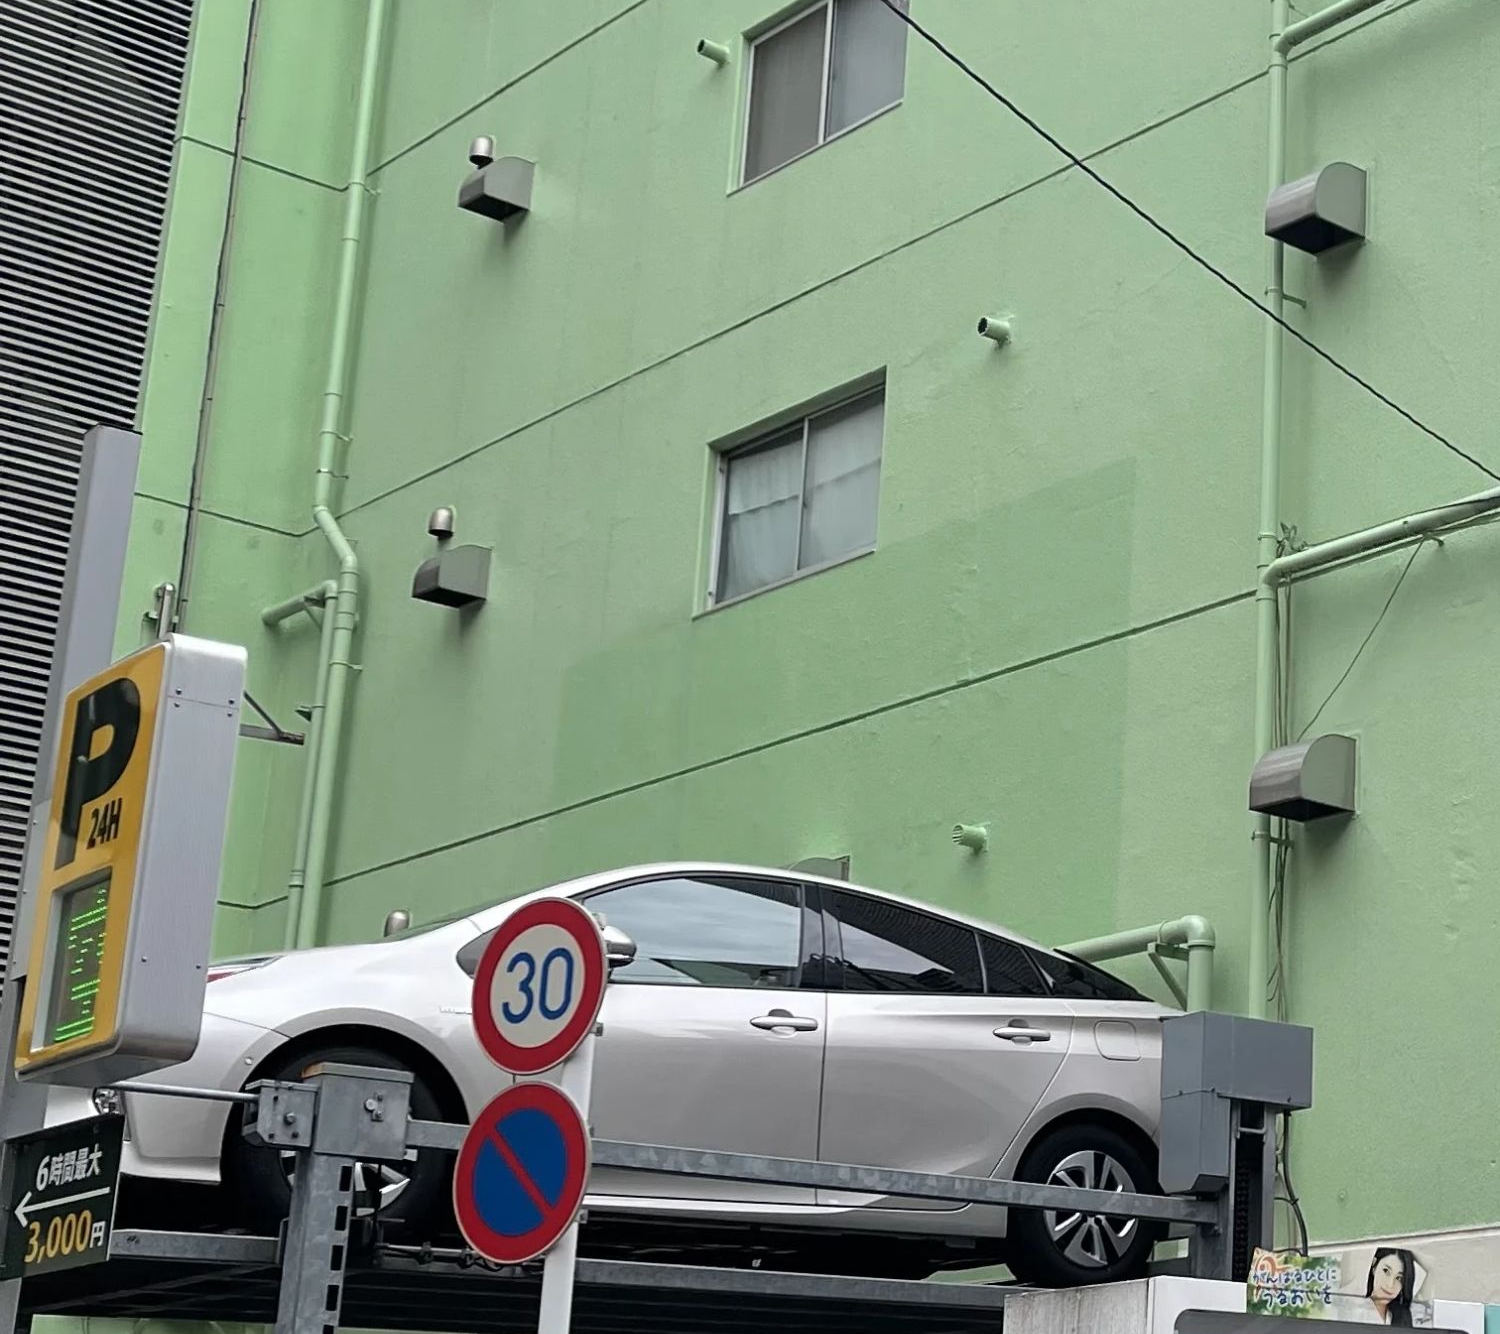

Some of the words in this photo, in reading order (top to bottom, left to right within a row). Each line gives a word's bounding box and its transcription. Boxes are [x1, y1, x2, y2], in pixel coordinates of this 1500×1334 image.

[56, 677, 141, 869] P
[86, 797, 122, 850] 24H
[502, 947, 573, 1025] 30
[36, 1143, 102, 1191] 6時間最大
[24, 1209, 106, 1264] 3,000円
[1252, 1267, 1336, 1285] がんばるひとに
[1263, 1286, 1332, 1307] うるおいを
